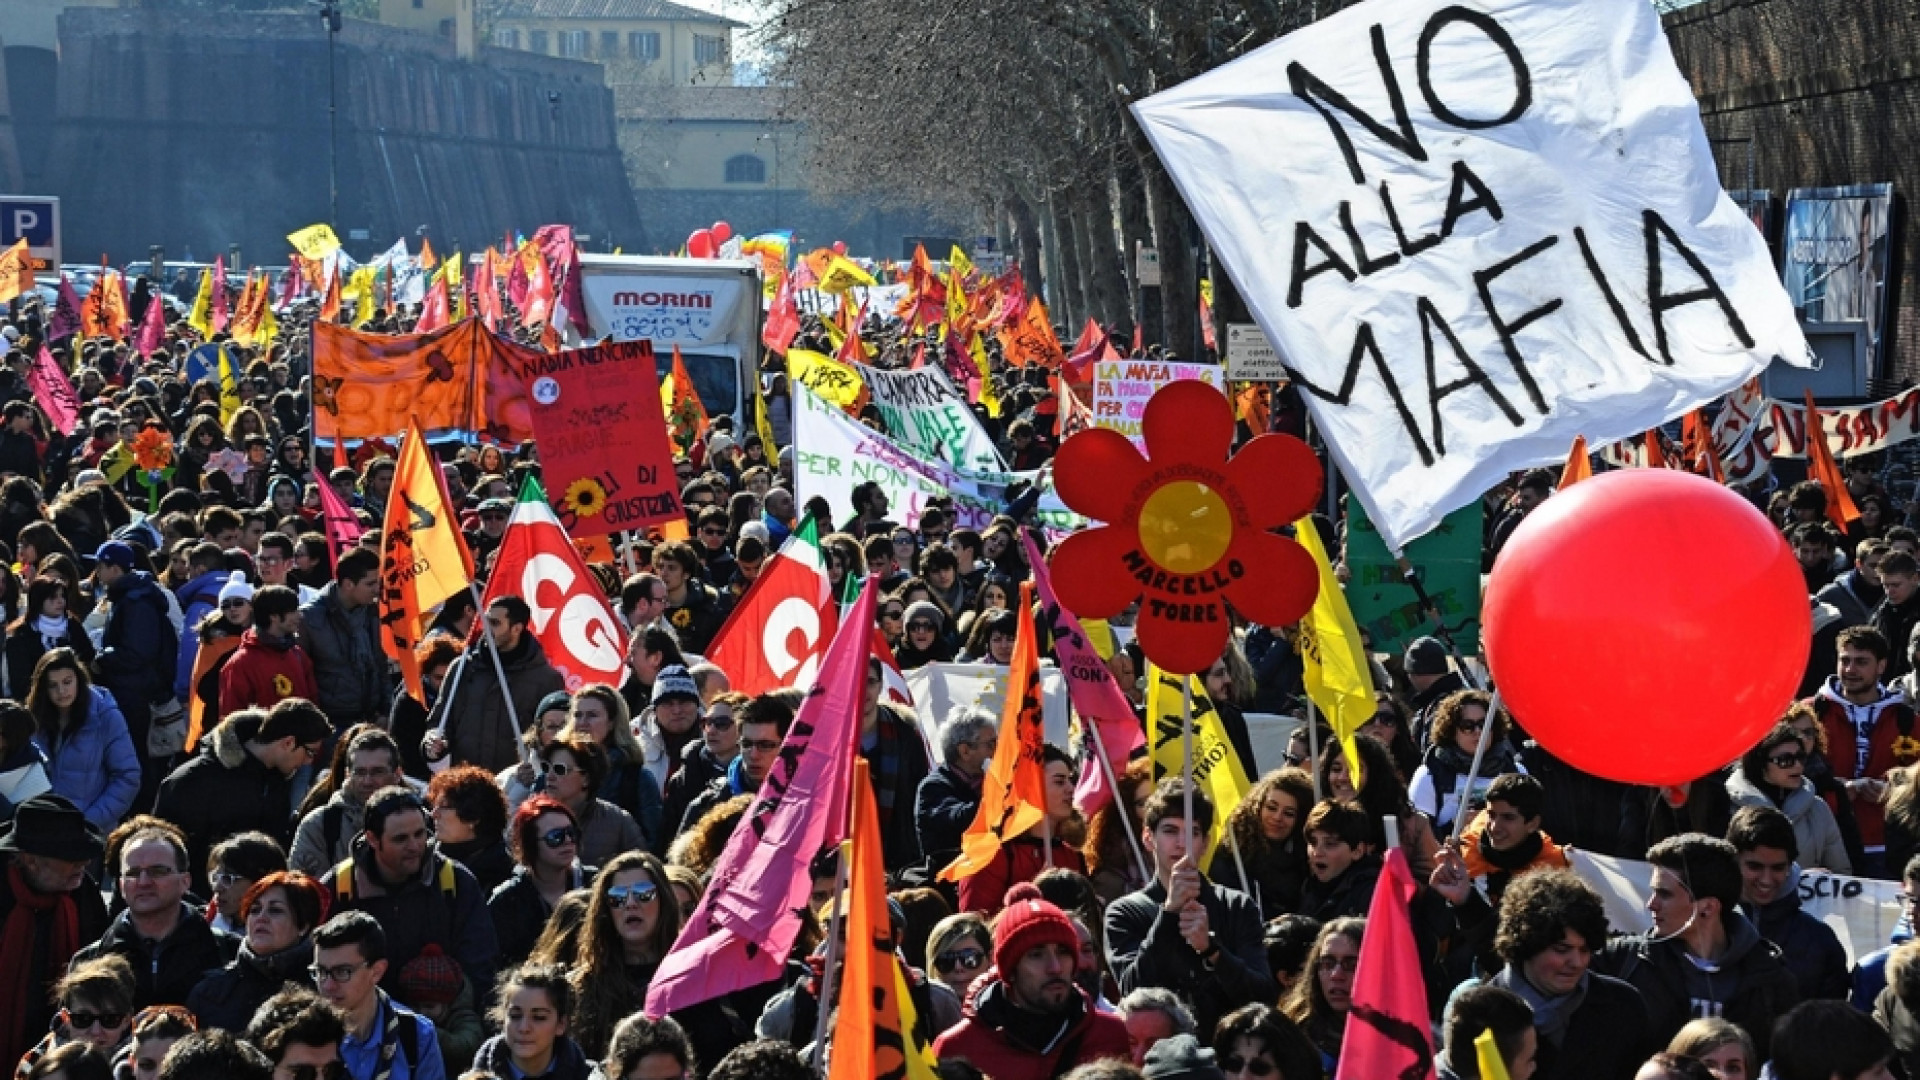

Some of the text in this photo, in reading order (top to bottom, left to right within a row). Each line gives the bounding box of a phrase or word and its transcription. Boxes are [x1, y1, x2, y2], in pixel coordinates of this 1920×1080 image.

[1286, 5, 1532, 184] NO
[14, 209, 39, 237] P
[1286, 160, 1503, 308] ALLA
[613, 292, 712, 308] MORINI
[1297, 208, 1756, 467] MAFIA
[523, 352, 574, 377] NADIA
[579, 340, 653, 366] NENCIONI
[1099, 363, 1122, 380] LA
[1126, 363, 1171, 381] MAFIA
[1097, 401, 1123, 416] PER
[638, 465, 657, 485] DI
[797, 451, 842, 477] PER
[851, 459, 909, 488] NON
[1121, 549, 1245, 596] MARCELLO
[1150, 598, 1218, 623] TORRE
